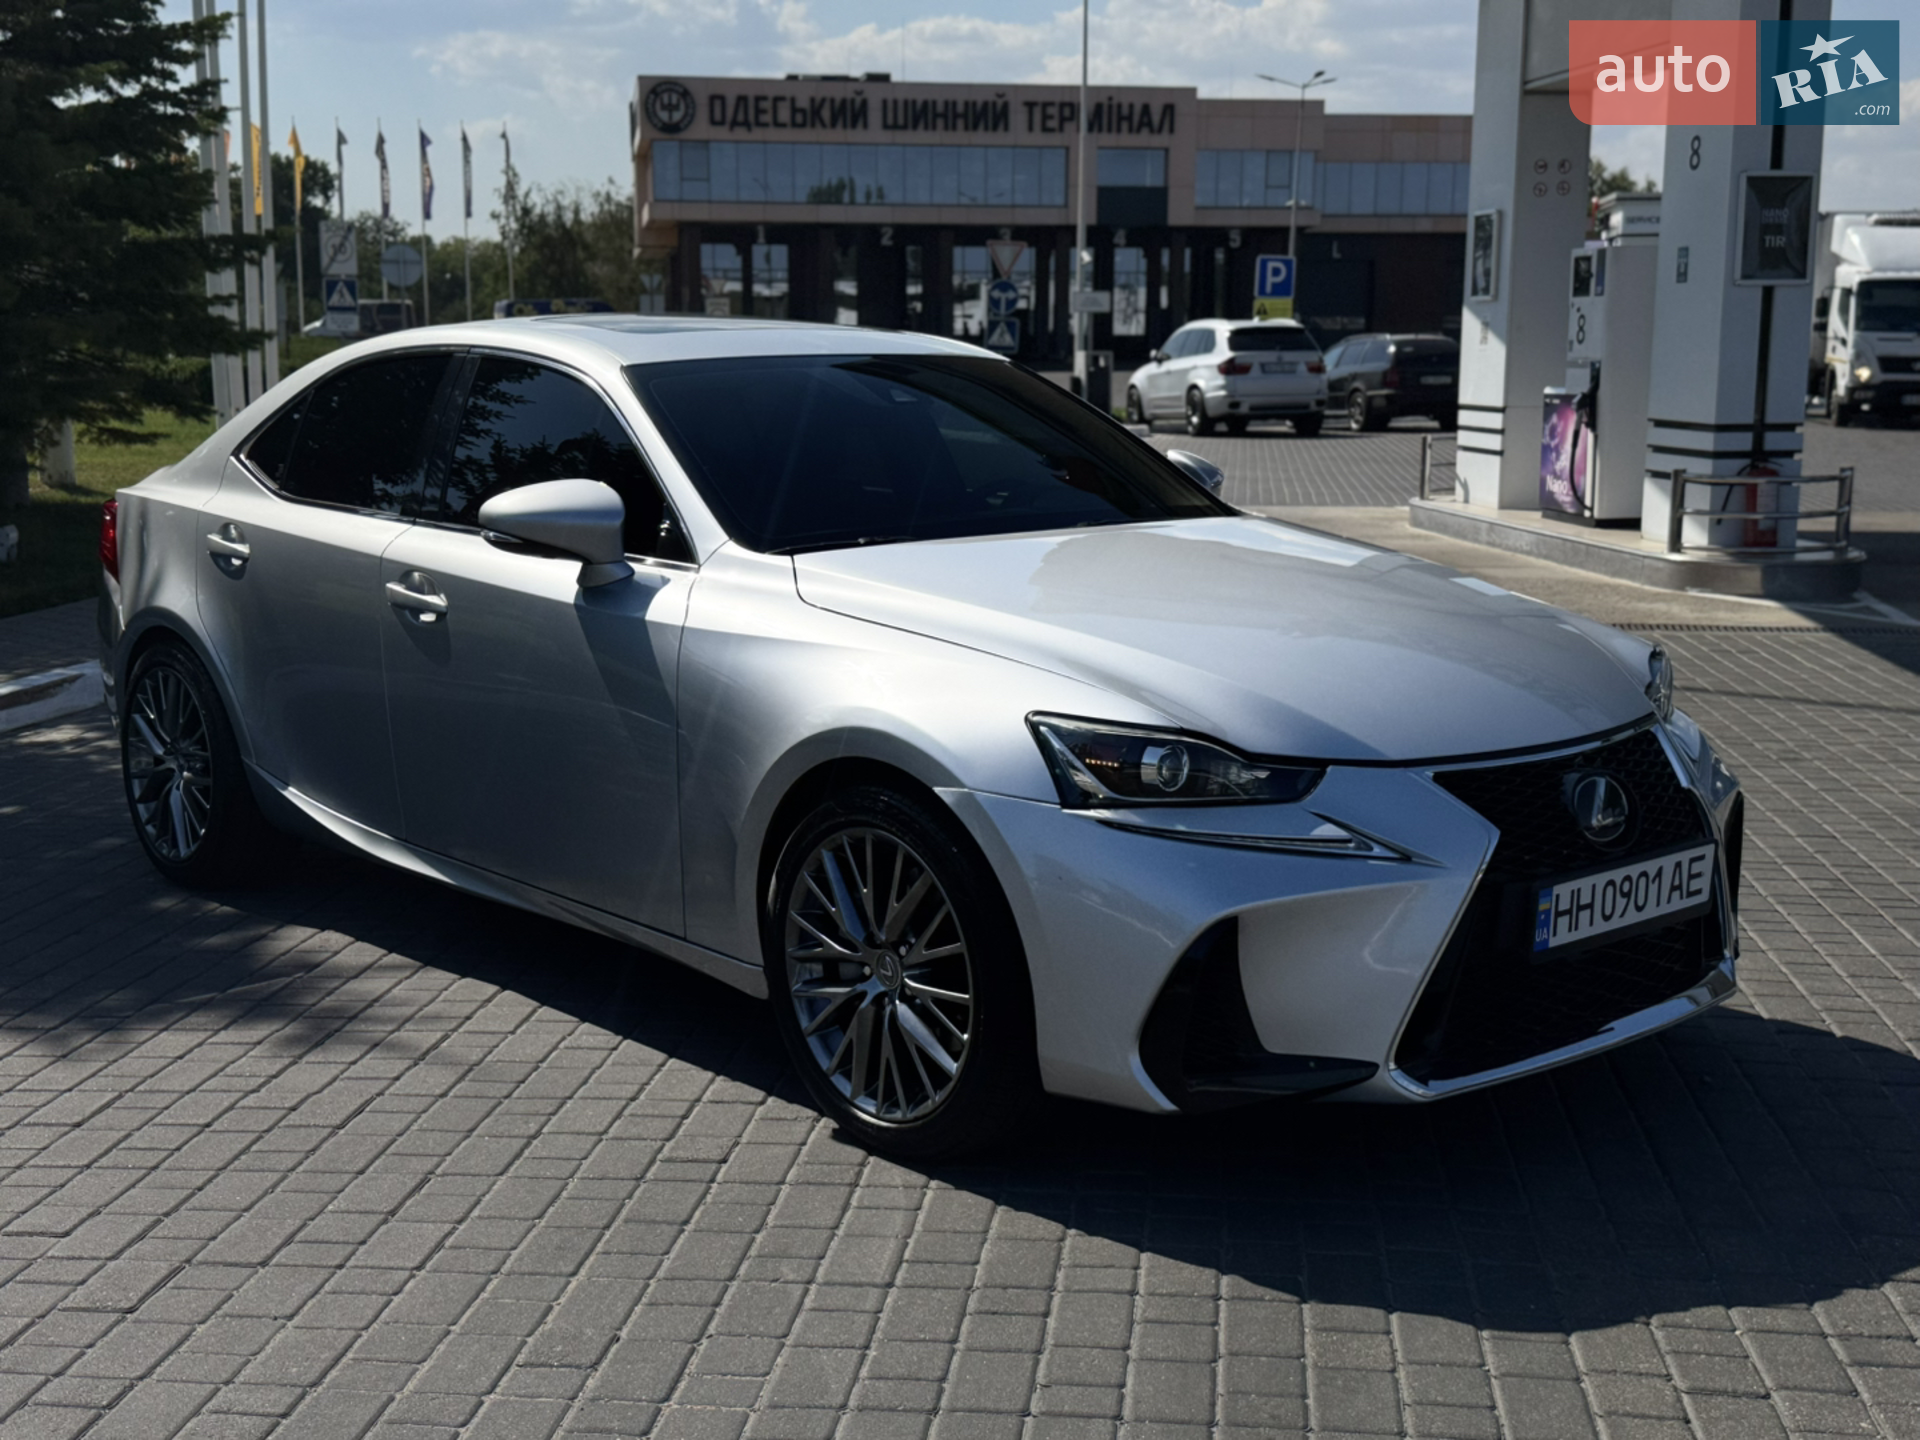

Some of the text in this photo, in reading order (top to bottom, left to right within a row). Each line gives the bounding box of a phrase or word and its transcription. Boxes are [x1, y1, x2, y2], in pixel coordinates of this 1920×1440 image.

[709, 90, 868, 132] ОДЕСЬКИЙ
[881, 92, 1009, 132] ШИННИЙ
[1688, 135, 1701, 171] 8
[880, 227, 894, 246] 2
[1112, 228, 1127, 247] 4
[1764, 234, 1787, 248] TIR
[1265, 260, 1287, 294] P
[1576, 313, 1586, 345] 8
[1546, 473, 1569, 495] Nano
[1535, 926, 1549, 942] UA
